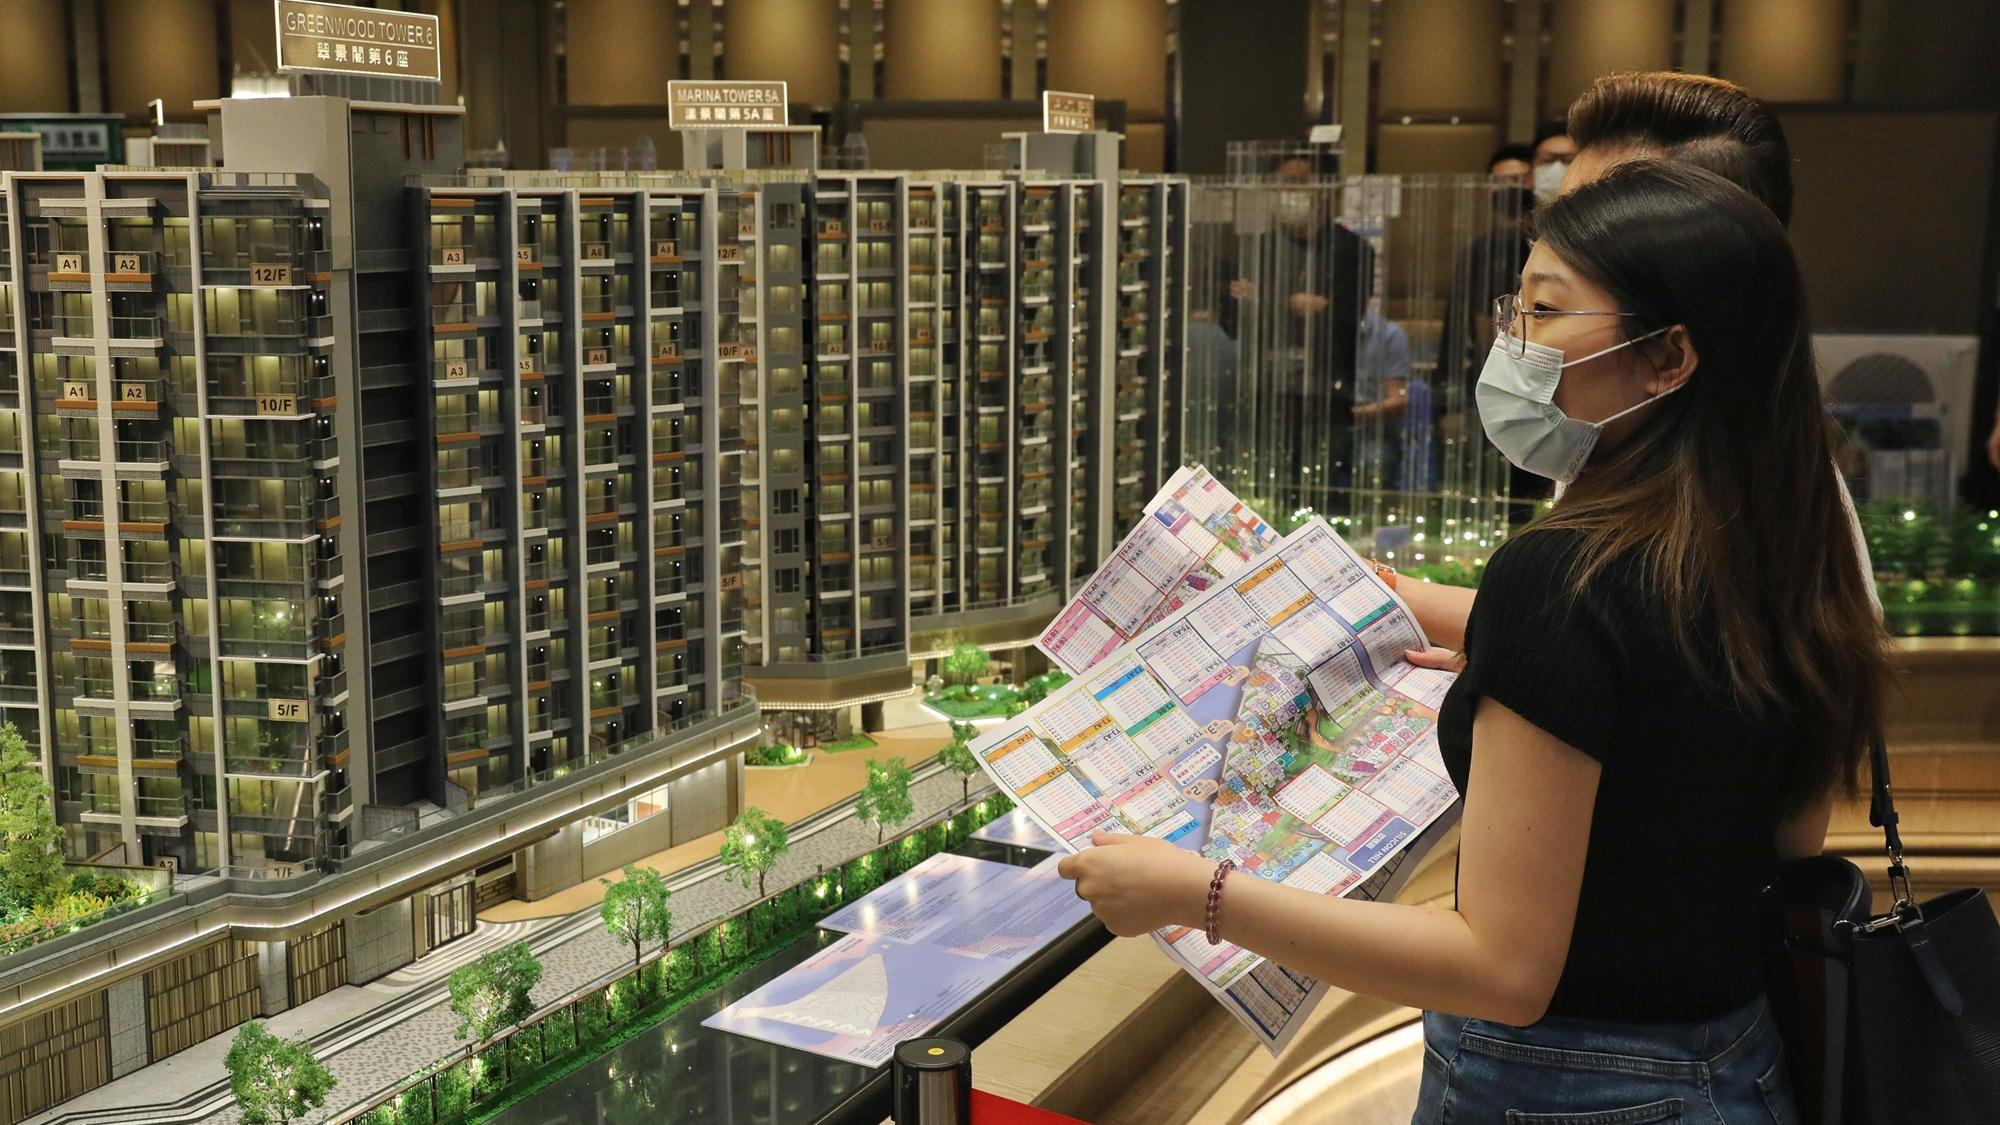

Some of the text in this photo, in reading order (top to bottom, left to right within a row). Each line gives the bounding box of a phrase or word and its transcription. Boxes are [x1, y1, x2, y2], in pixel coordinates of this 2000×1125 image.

[286, 12, 433, 45] GREENWOOD TOWER 6
[677, 88, 779, 103] MARINA TOWER 5A
[447, 252, 460, 262] A3
[590, 248, 603, 257] A6
[718, 248, 737, 259] 12/F
[63, 259, 77, 270] A1
[120, 259, 136, 270] A2
[254, 268, 287, 282] 12/F
[592, 353, 605, 362] A6
[718, 346, 738, 356] 10/F
[450, 366, 464, 377] A3
[69, 387, 84, 397] A1
[127, 388, 142, 398] A2
[260, 398, 292, 412] 10/F
[1266, 561, 1283, 574] T5-A2
[1296, 593, 1313, 606] T5-A2
[1172, 623, 1190, 638] T5-A3
[1204, 658, 1222, 672] T5-A3
[1213, 666, 1232, 681] T5-A3
[277, 704, 299, 716] 5/F
[1093, 716, 1110, 730] T3-A2
[1016, 731, 1033, 745] T2-A2
[1102, 727, 1120, 741] T3-A3
[1184, 730, 1202, 745] T3-B2
[1046, 764, 1064, 778] T2-A2
[1135, 763, 1152, 777] T3-A3
[1143, 772, 1161, 786] T3-A3
[1380, 830, 1407, 853] SILICON
[1367, 850, 1383, 865] HILL
